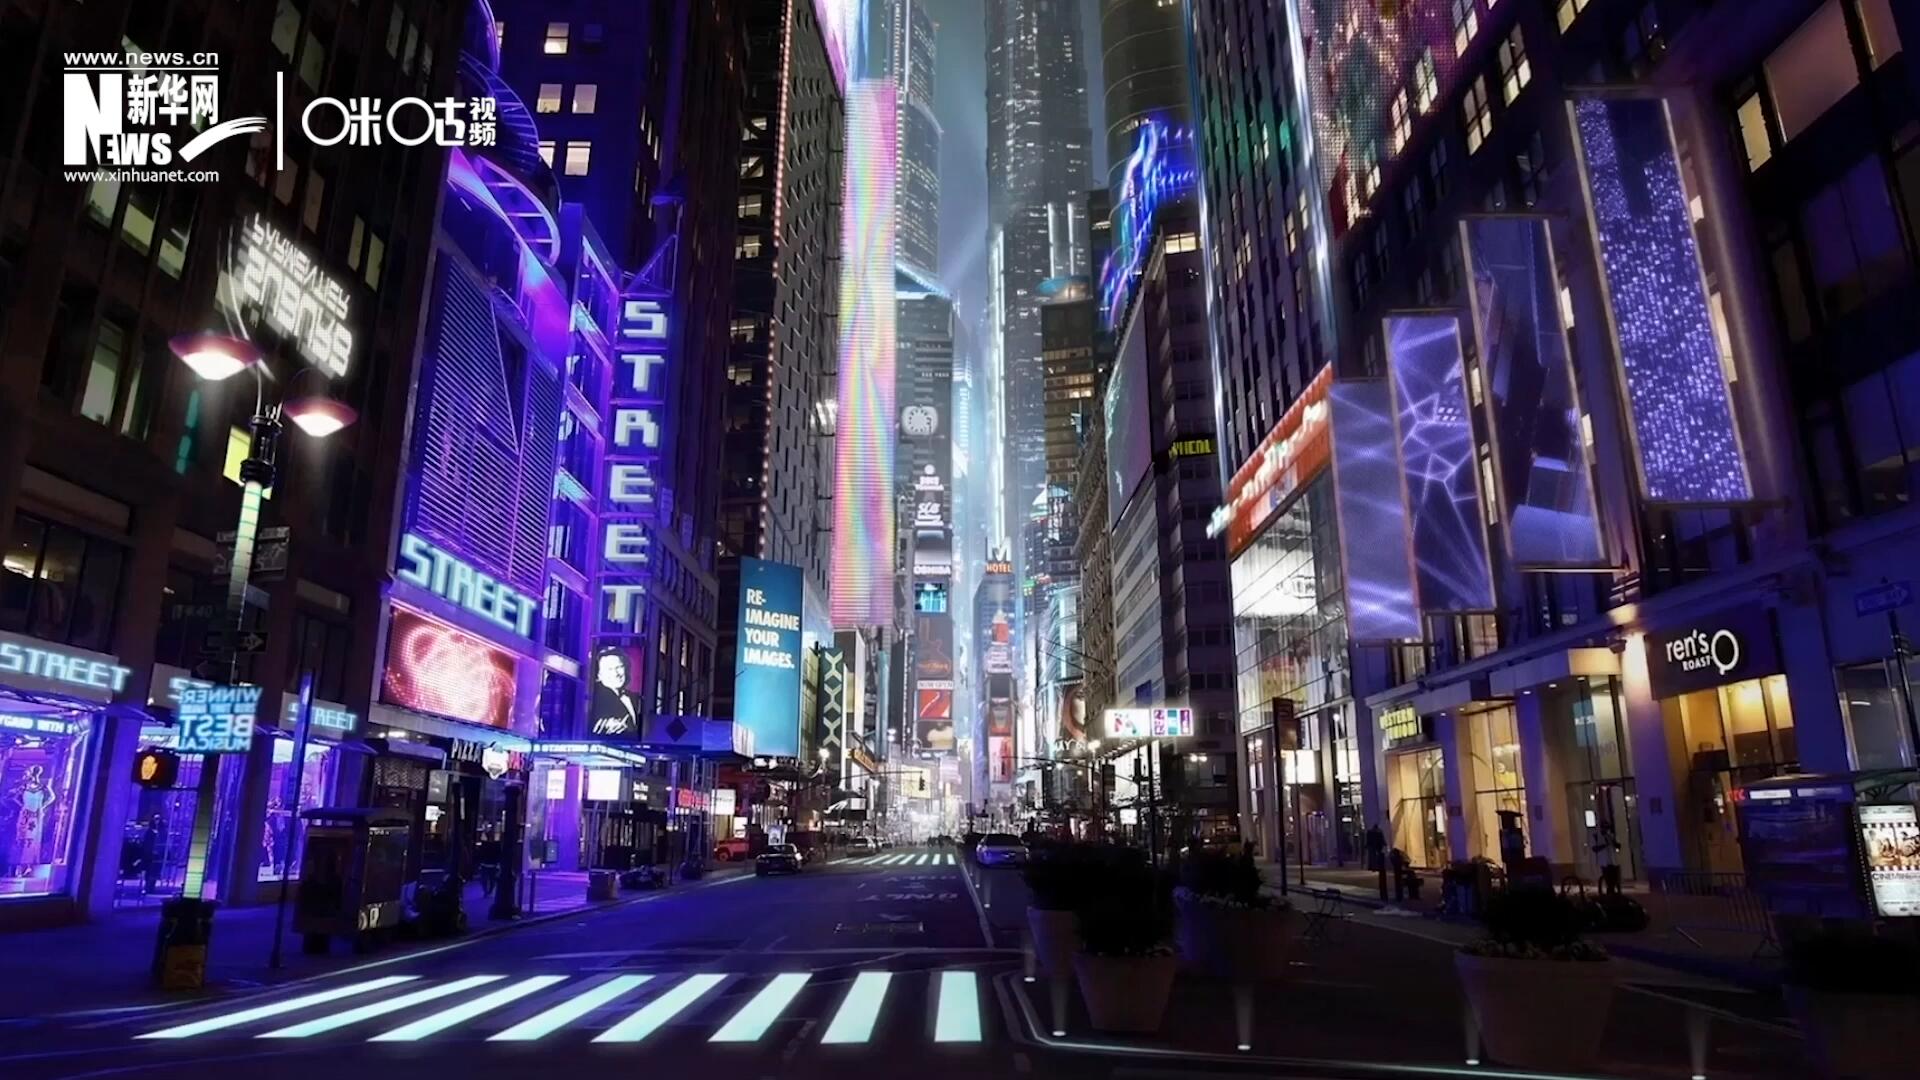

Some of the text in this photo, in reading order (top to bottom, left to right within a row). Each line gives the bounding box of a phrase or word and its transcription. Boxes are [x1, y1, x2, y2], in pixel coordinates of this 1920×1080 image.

[602, 300, 667, 624] STREET
[985, 561, 1012, 574] HOTEL
[397, 532, 537, 639] STREET
[746, 588, 767, 606] RE-
[745, 608, 800, 632] IMAGINE
[744, 628, 780, 648] YOUR
[1665, 628, 1710, 662] ren's
[0, 642, 132, 692] STREET
[743, 647, 795, 669] IMAGES.
[1682, 655, 1711, 671] ROAST
[451, 738, 481, 763] PIZZA
